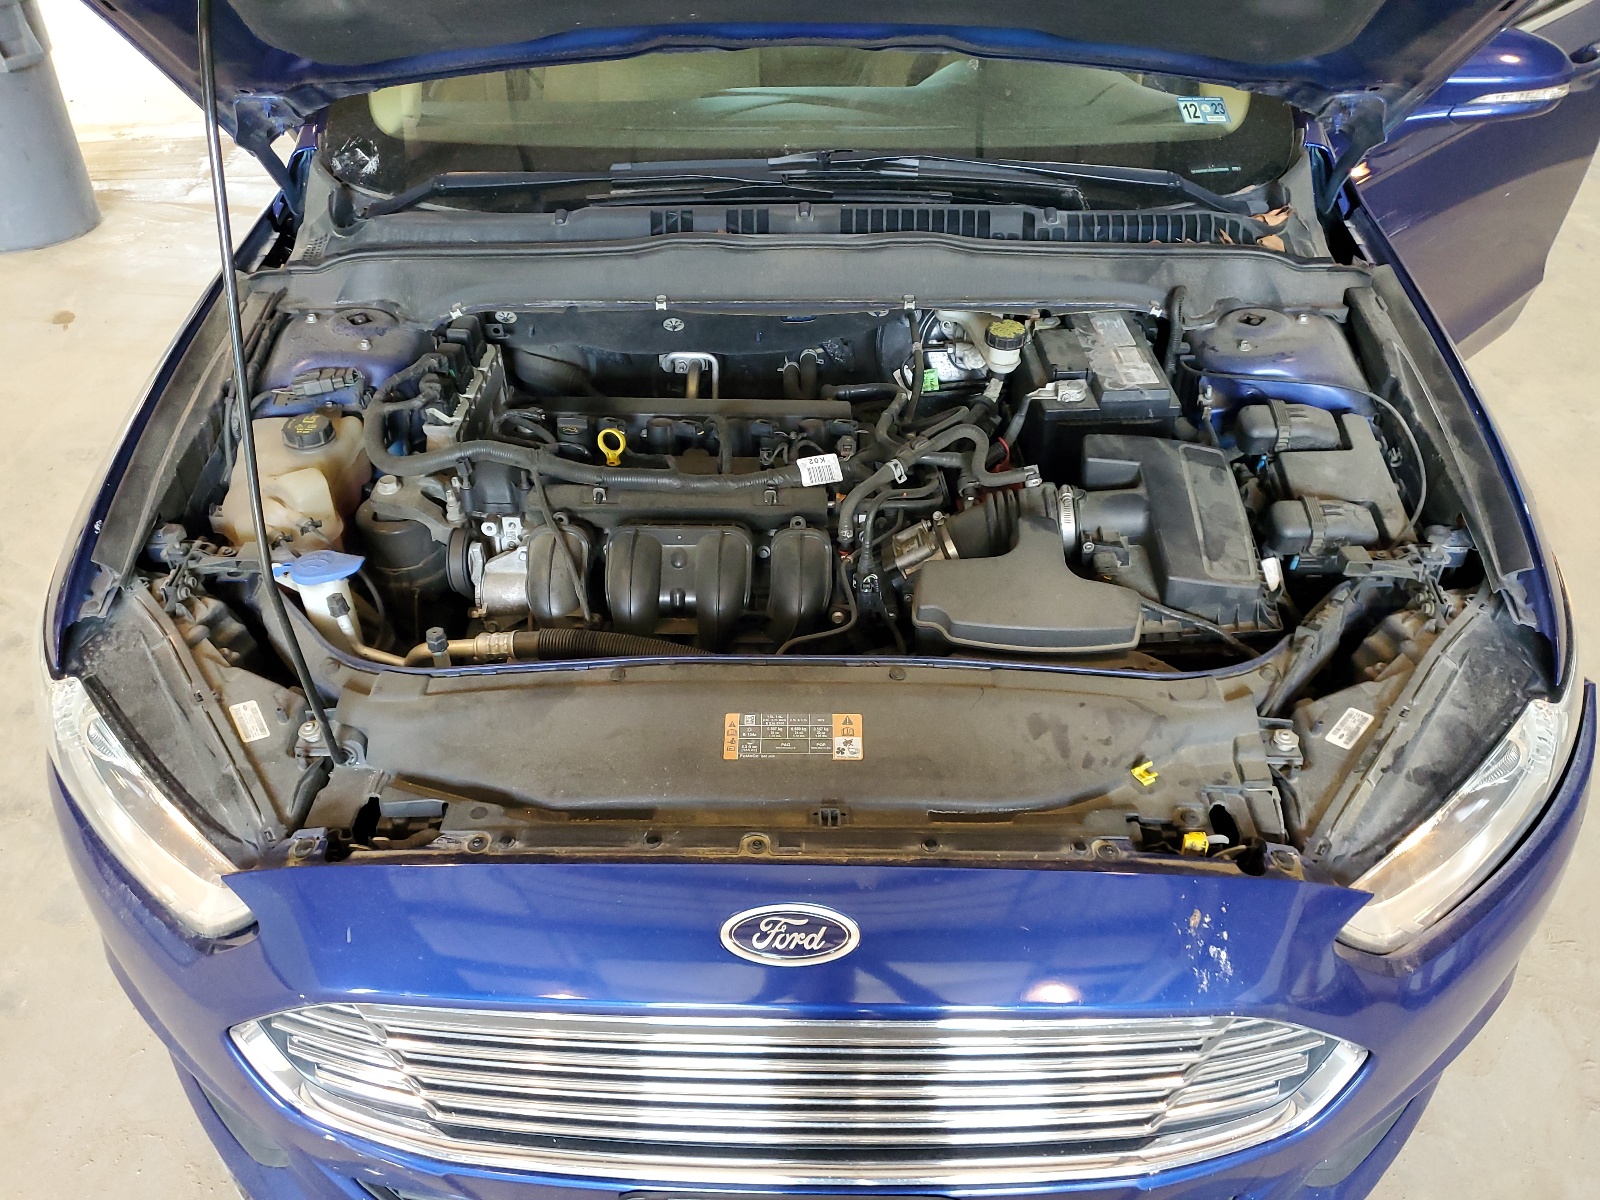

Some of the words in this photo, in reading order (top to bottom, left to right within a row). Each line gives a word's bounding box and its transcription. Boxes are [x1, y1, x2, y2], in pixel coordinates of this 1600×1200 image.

[1183, 103, 1200, 119] 12
[1211, 103, 1226, 114] 23
[752, 917, 828, 951] Ford
